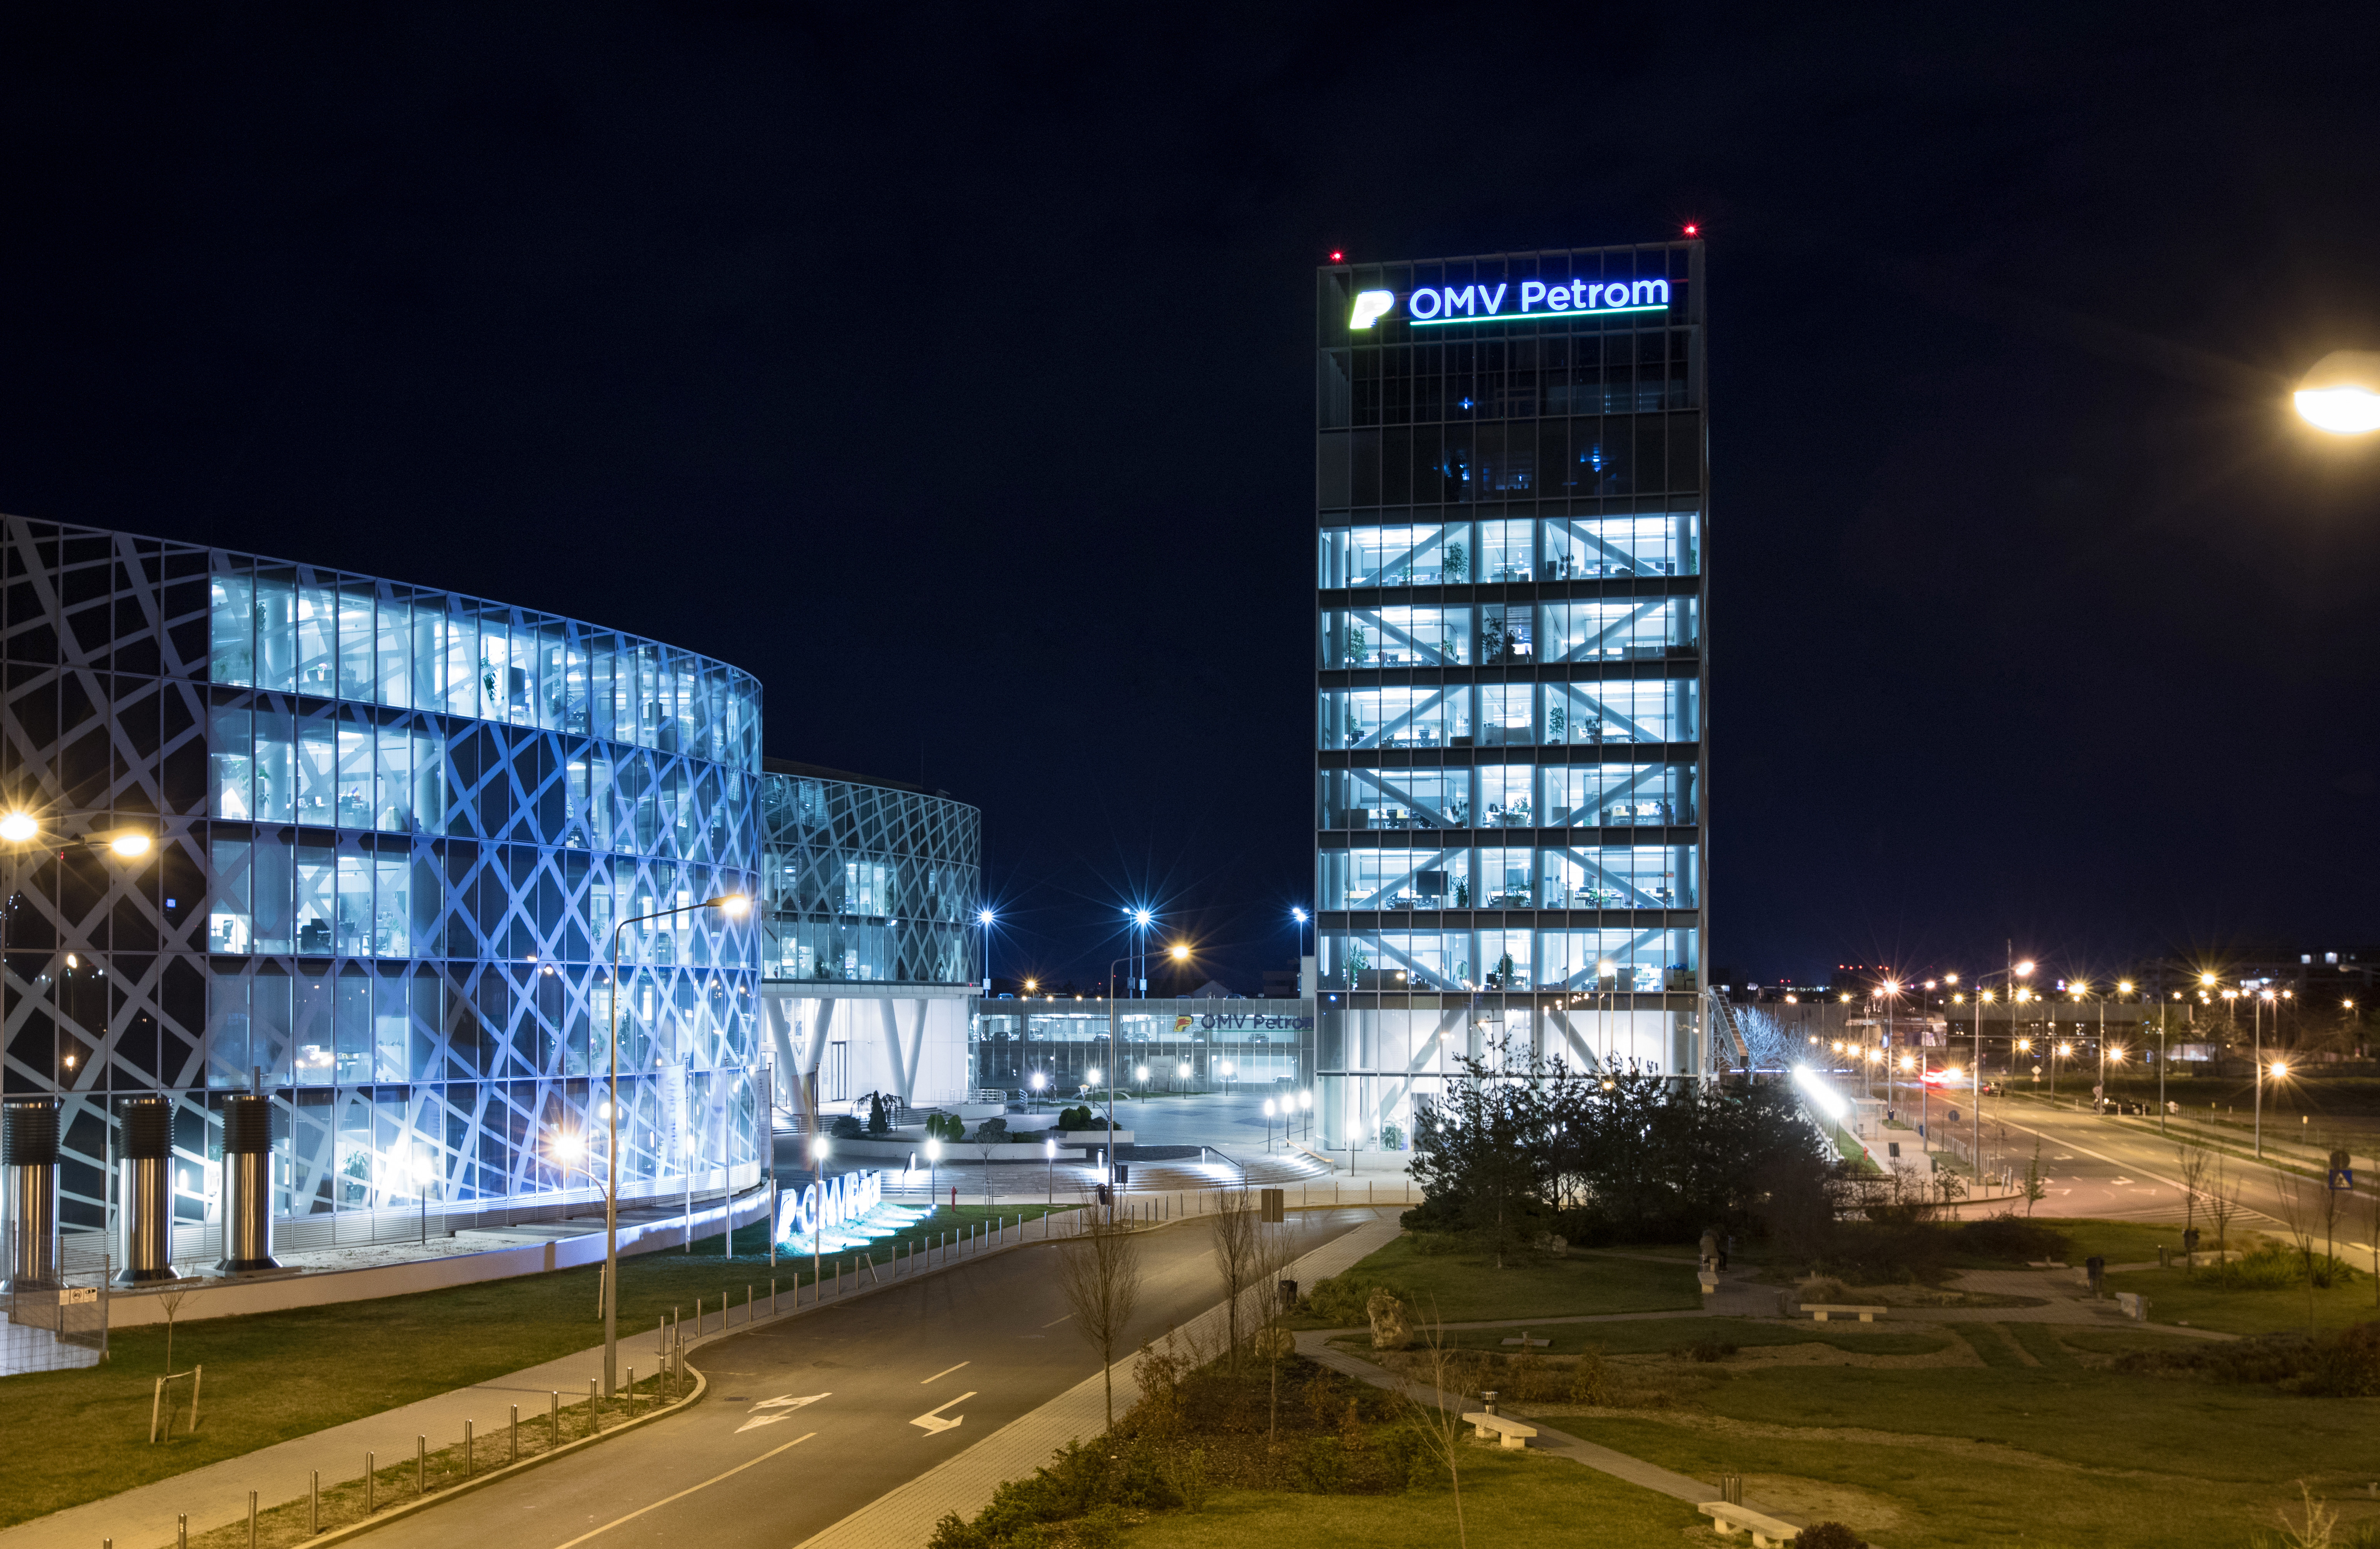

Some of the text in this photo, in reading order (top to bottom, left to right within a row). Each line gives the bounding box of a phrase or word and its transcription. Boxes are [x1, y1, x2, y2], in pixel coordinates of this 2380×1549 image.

[1409, 282, 1508, 320] OMV
[1521, 278, 1669, 313] Petrom
[1201, 1014, 1247, 1029] OMV
